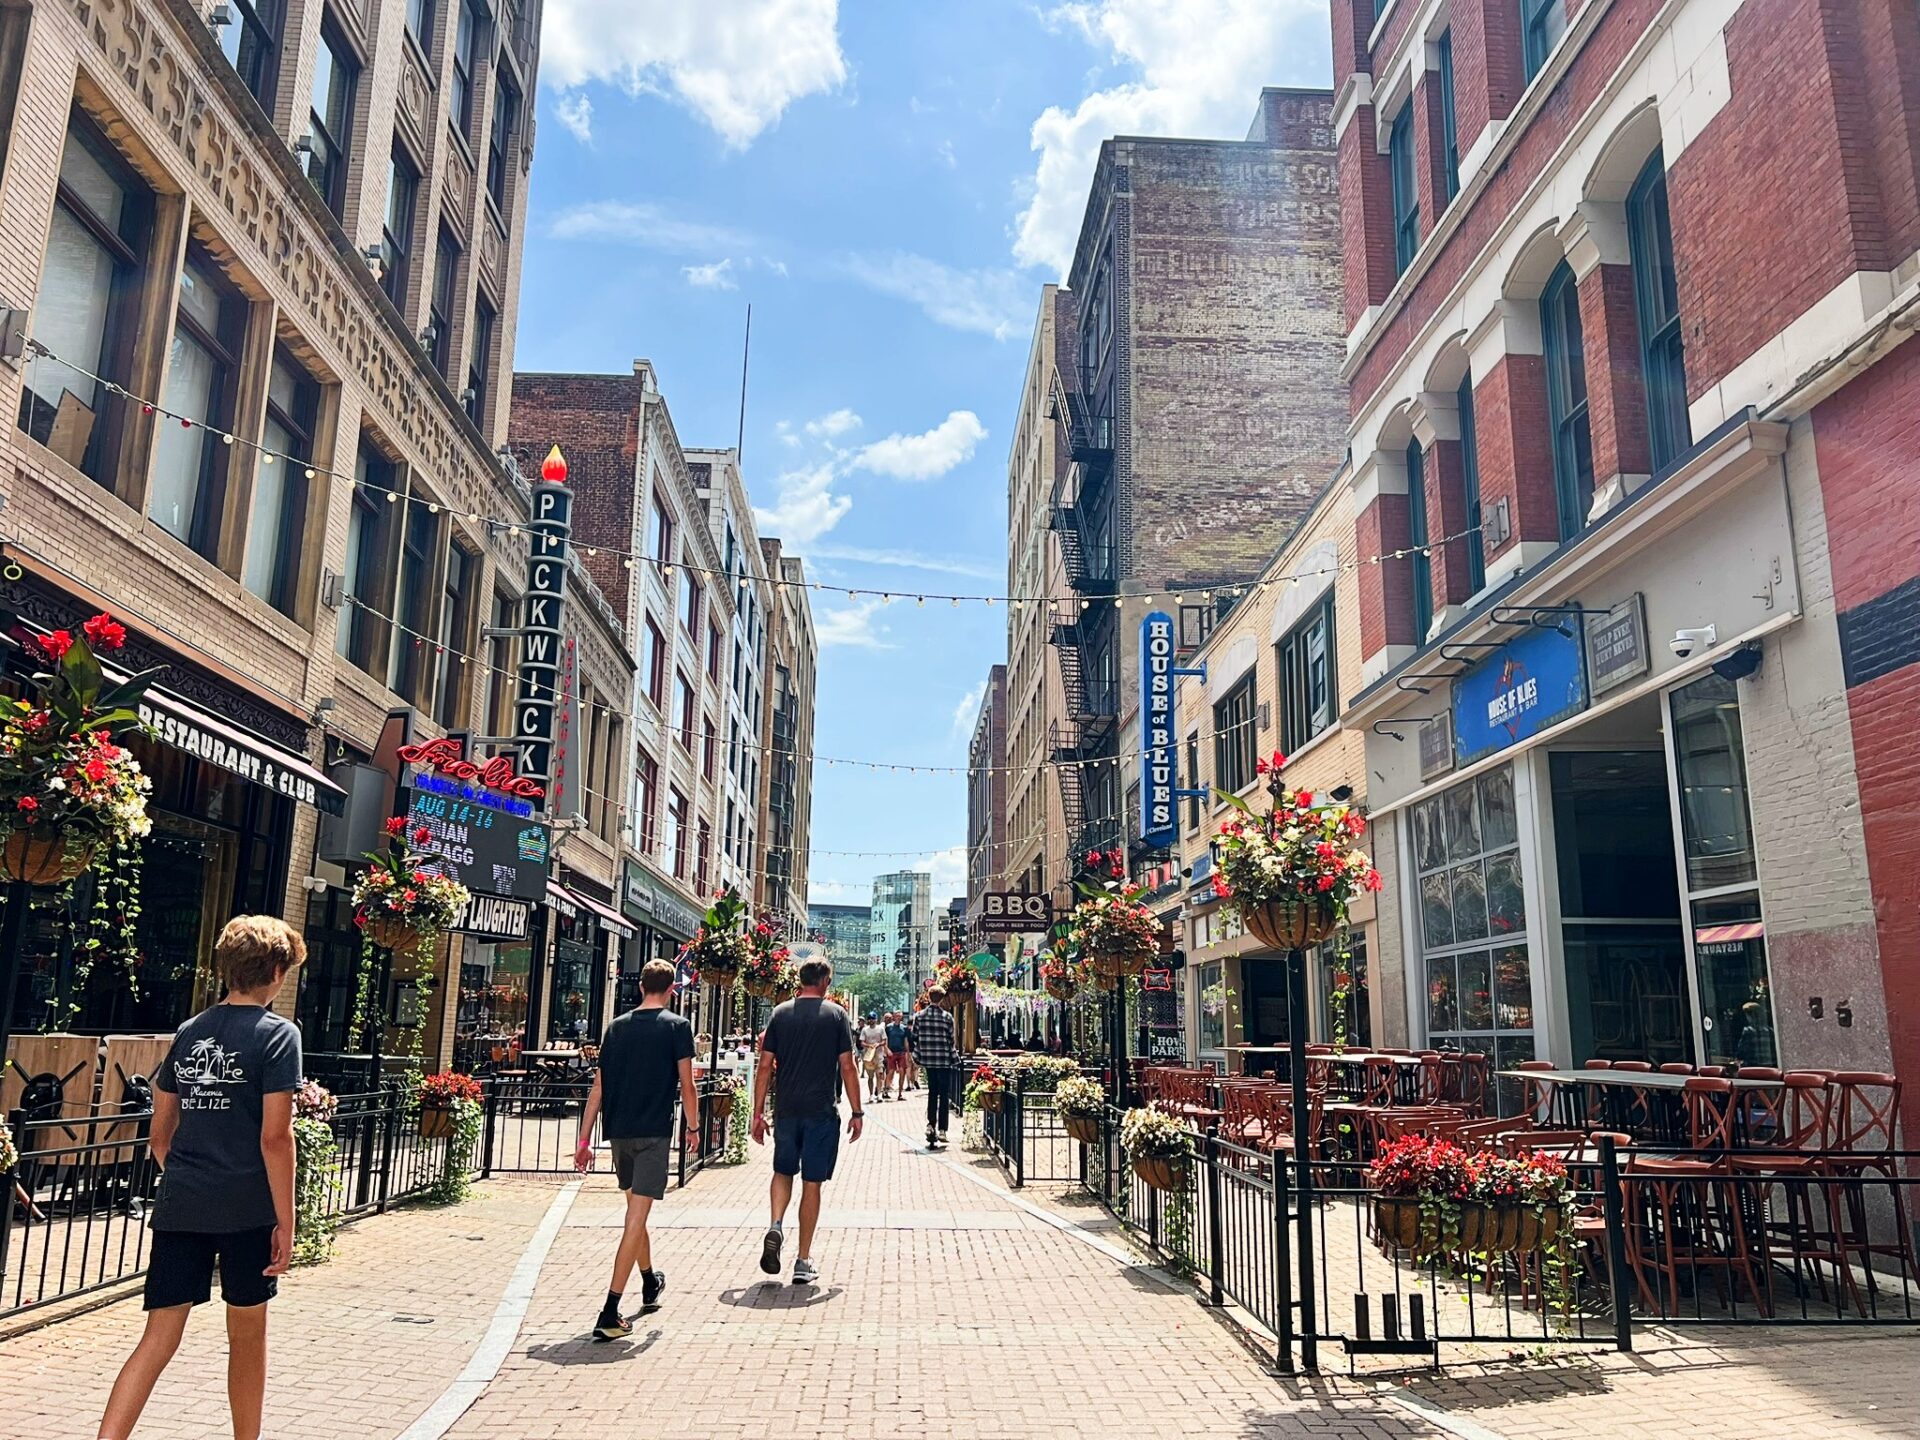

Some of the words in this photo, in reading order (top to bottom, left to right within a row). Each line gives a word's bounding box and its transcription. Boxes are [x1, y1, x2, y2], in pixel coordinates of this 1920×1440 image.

[522, 494, 555, 771] PICKWICK
[1150, 622, 1170, 711] HOUSE
[1152, 714, 1165, 724] of
[1488, 694, 1507, 720] HOUSE
[1508, 689, 1516, 710] OF
[1516, 677, 1537, 704] BLUES
[1525, 697, 1538, 710] BAR
[139, 703, 261, 781] RESTAURANT
[264, 763, 275, 788] &
[279, 771, 316, 804] CLUB
[397, 738, 546, 797] Frolic
[1152, 729, 1170, 823] BLUES
[415, 795, 446, 817] AUG
[449, 803, 493, 829] 14-16
[469, 897, 527, 937] LAUGHTER
[987, 896, 1047, 919] BBQ
[181, 1097, 231, 1110] BELIZE
